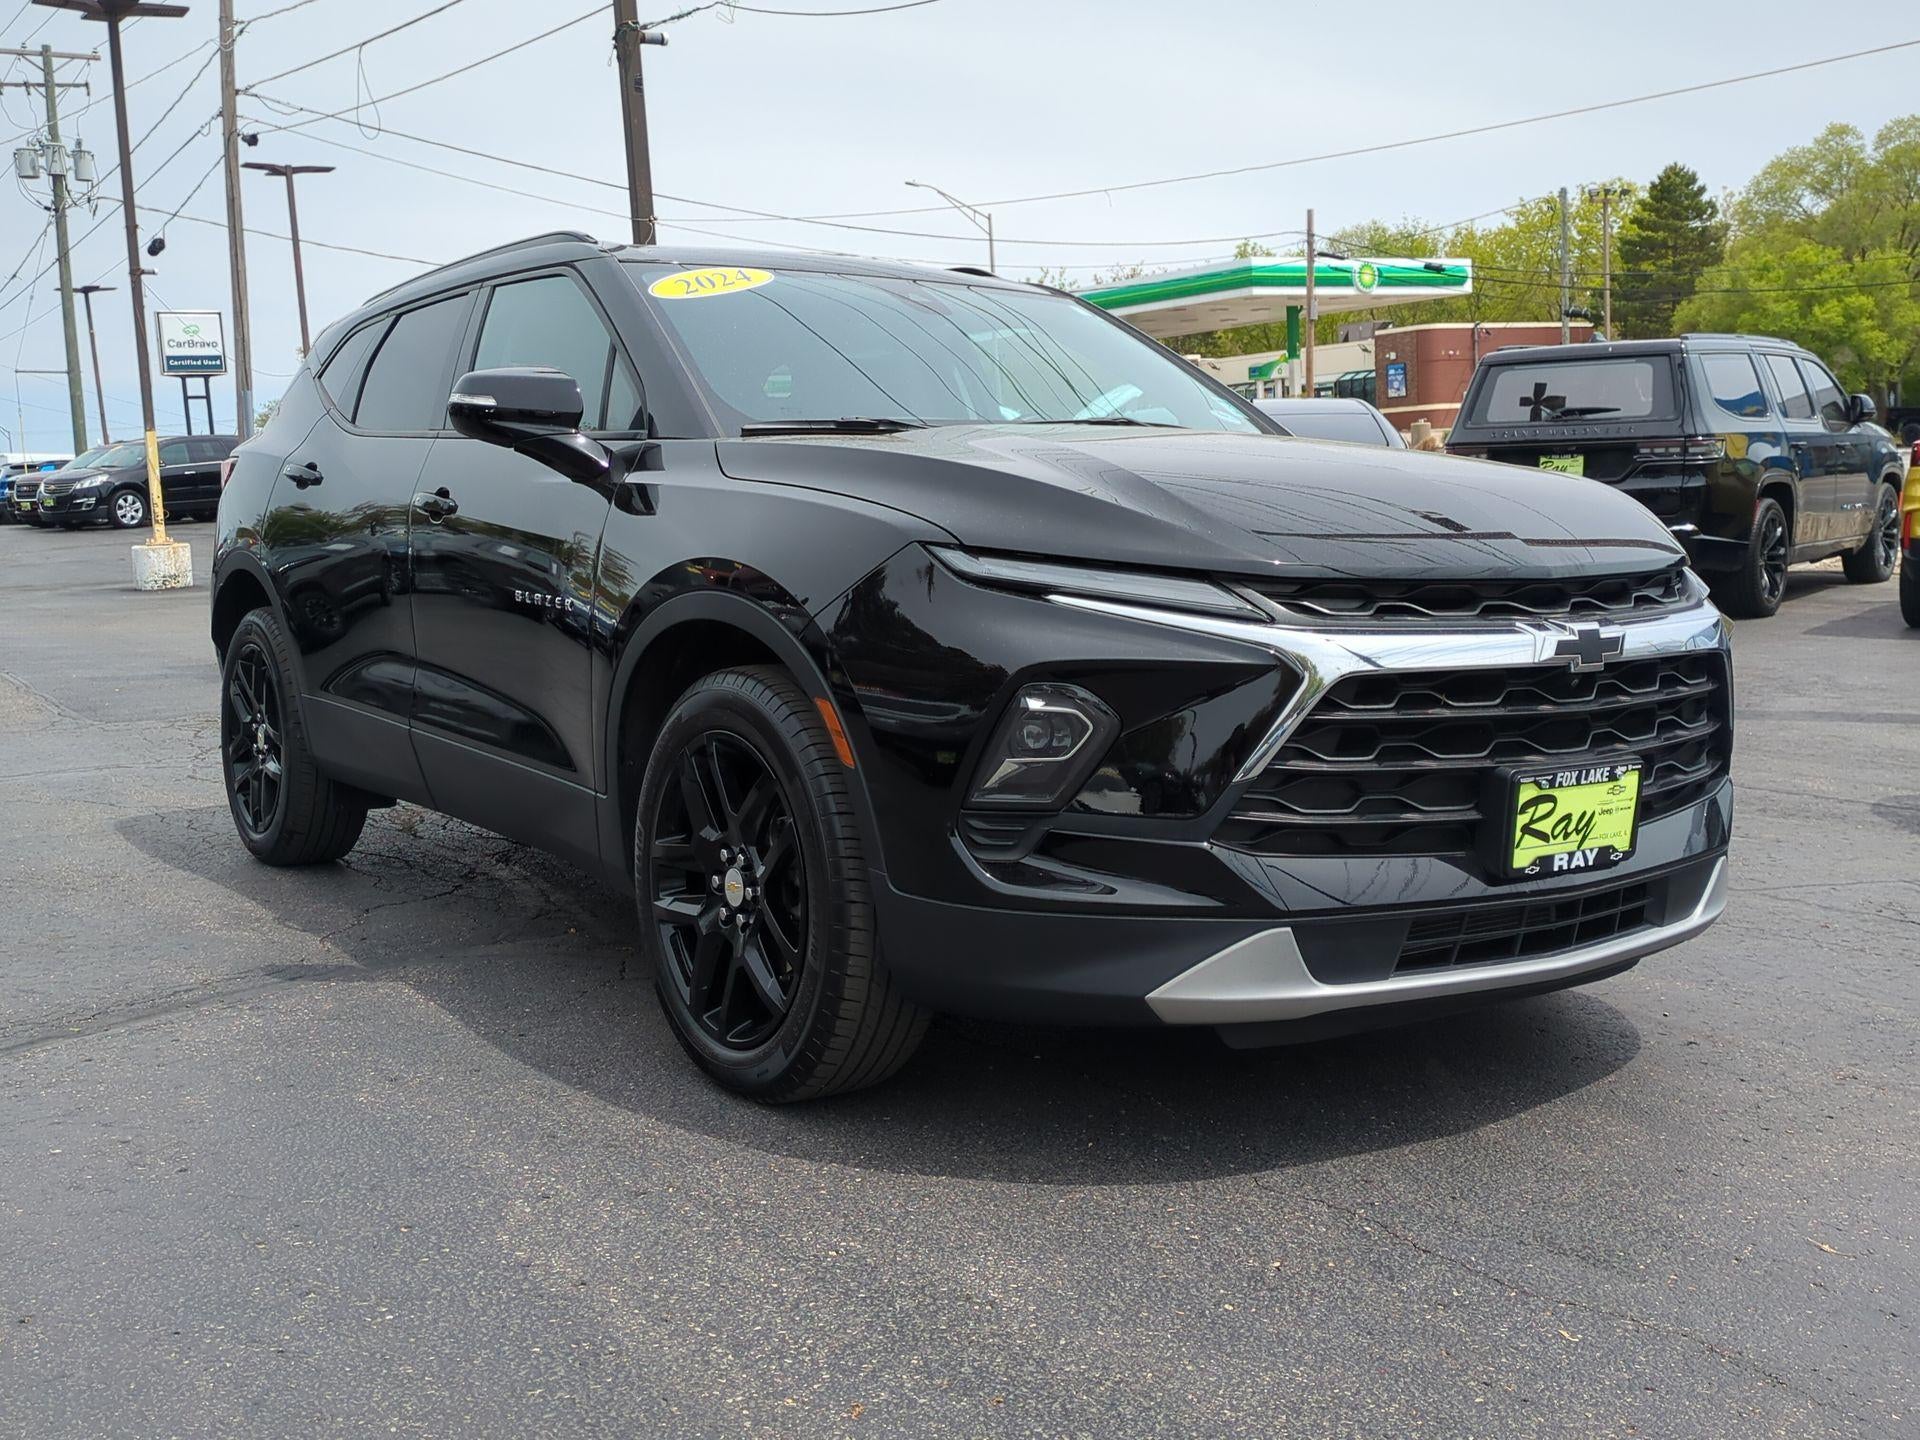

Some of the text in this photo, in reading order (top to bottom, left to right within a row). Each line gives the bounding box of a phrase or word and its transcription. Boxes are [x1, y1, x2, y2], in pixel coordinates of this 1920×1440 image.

[674, 269, 752, 295] 2024
[167, 339, 218, 348] CarBravo
[514, 590, 574, 612] BLAZER
[1555, 770, 1578, 787] FOX
[1581, 767, 1611, 785] LAKE
[1515, 794, 1597, 850] Ray
[1598, 807, 1613, 816] Jeep
[1553, 848, 1600, 872] RAY
